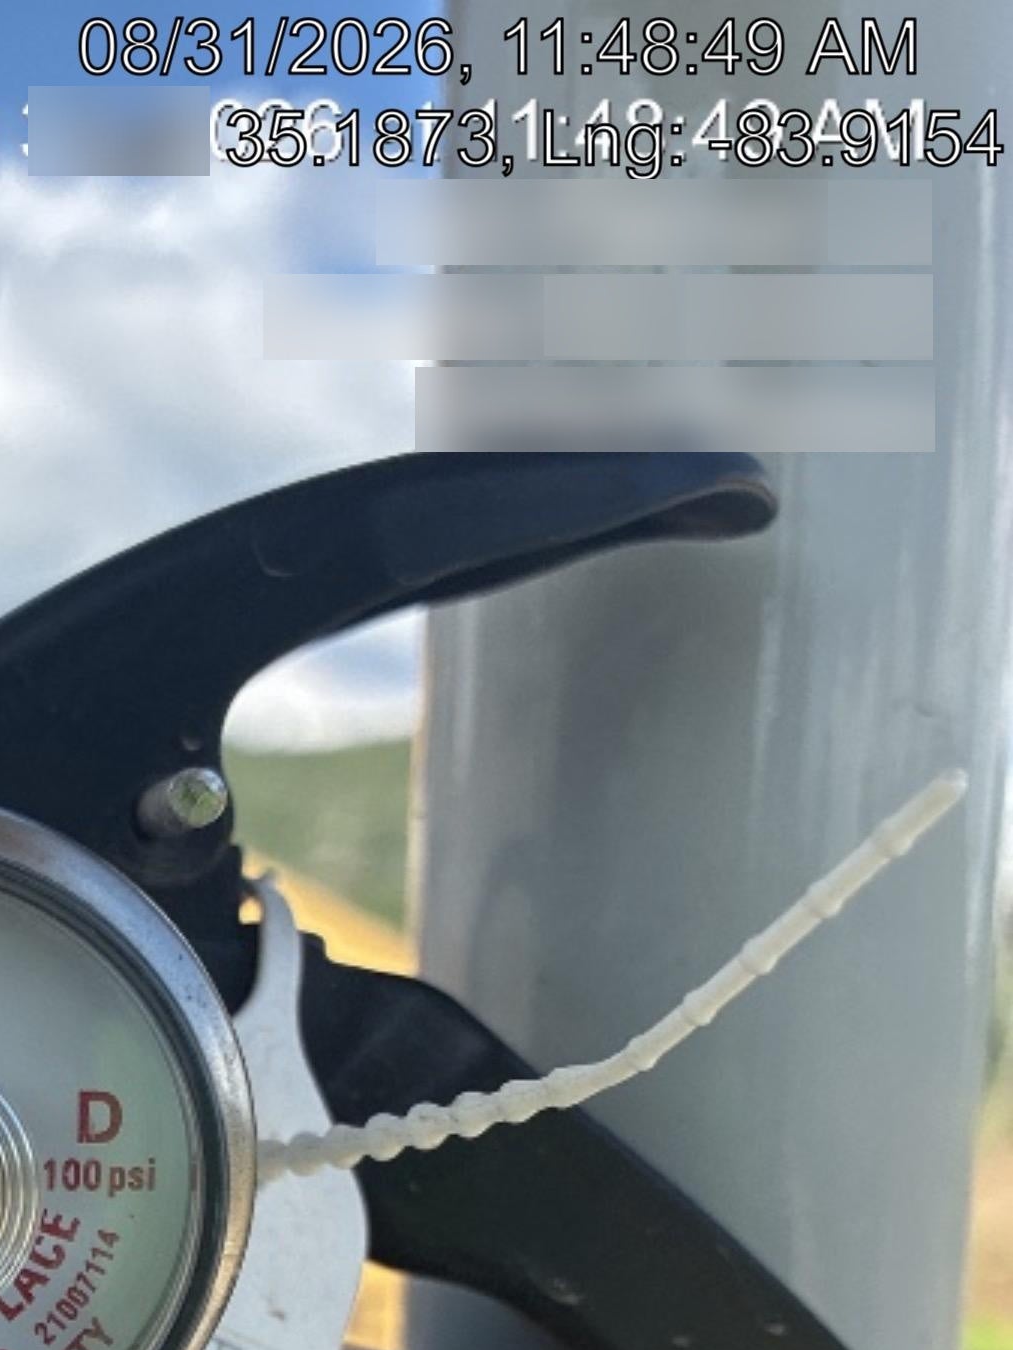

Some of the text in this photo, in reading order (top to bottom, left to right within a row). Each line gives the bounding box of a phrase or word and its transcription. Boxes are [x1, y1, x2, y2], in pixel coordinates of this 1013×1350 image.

[77, 1090, 123, 1144] D
[43, 1157, 157, 1198] 100 psi
